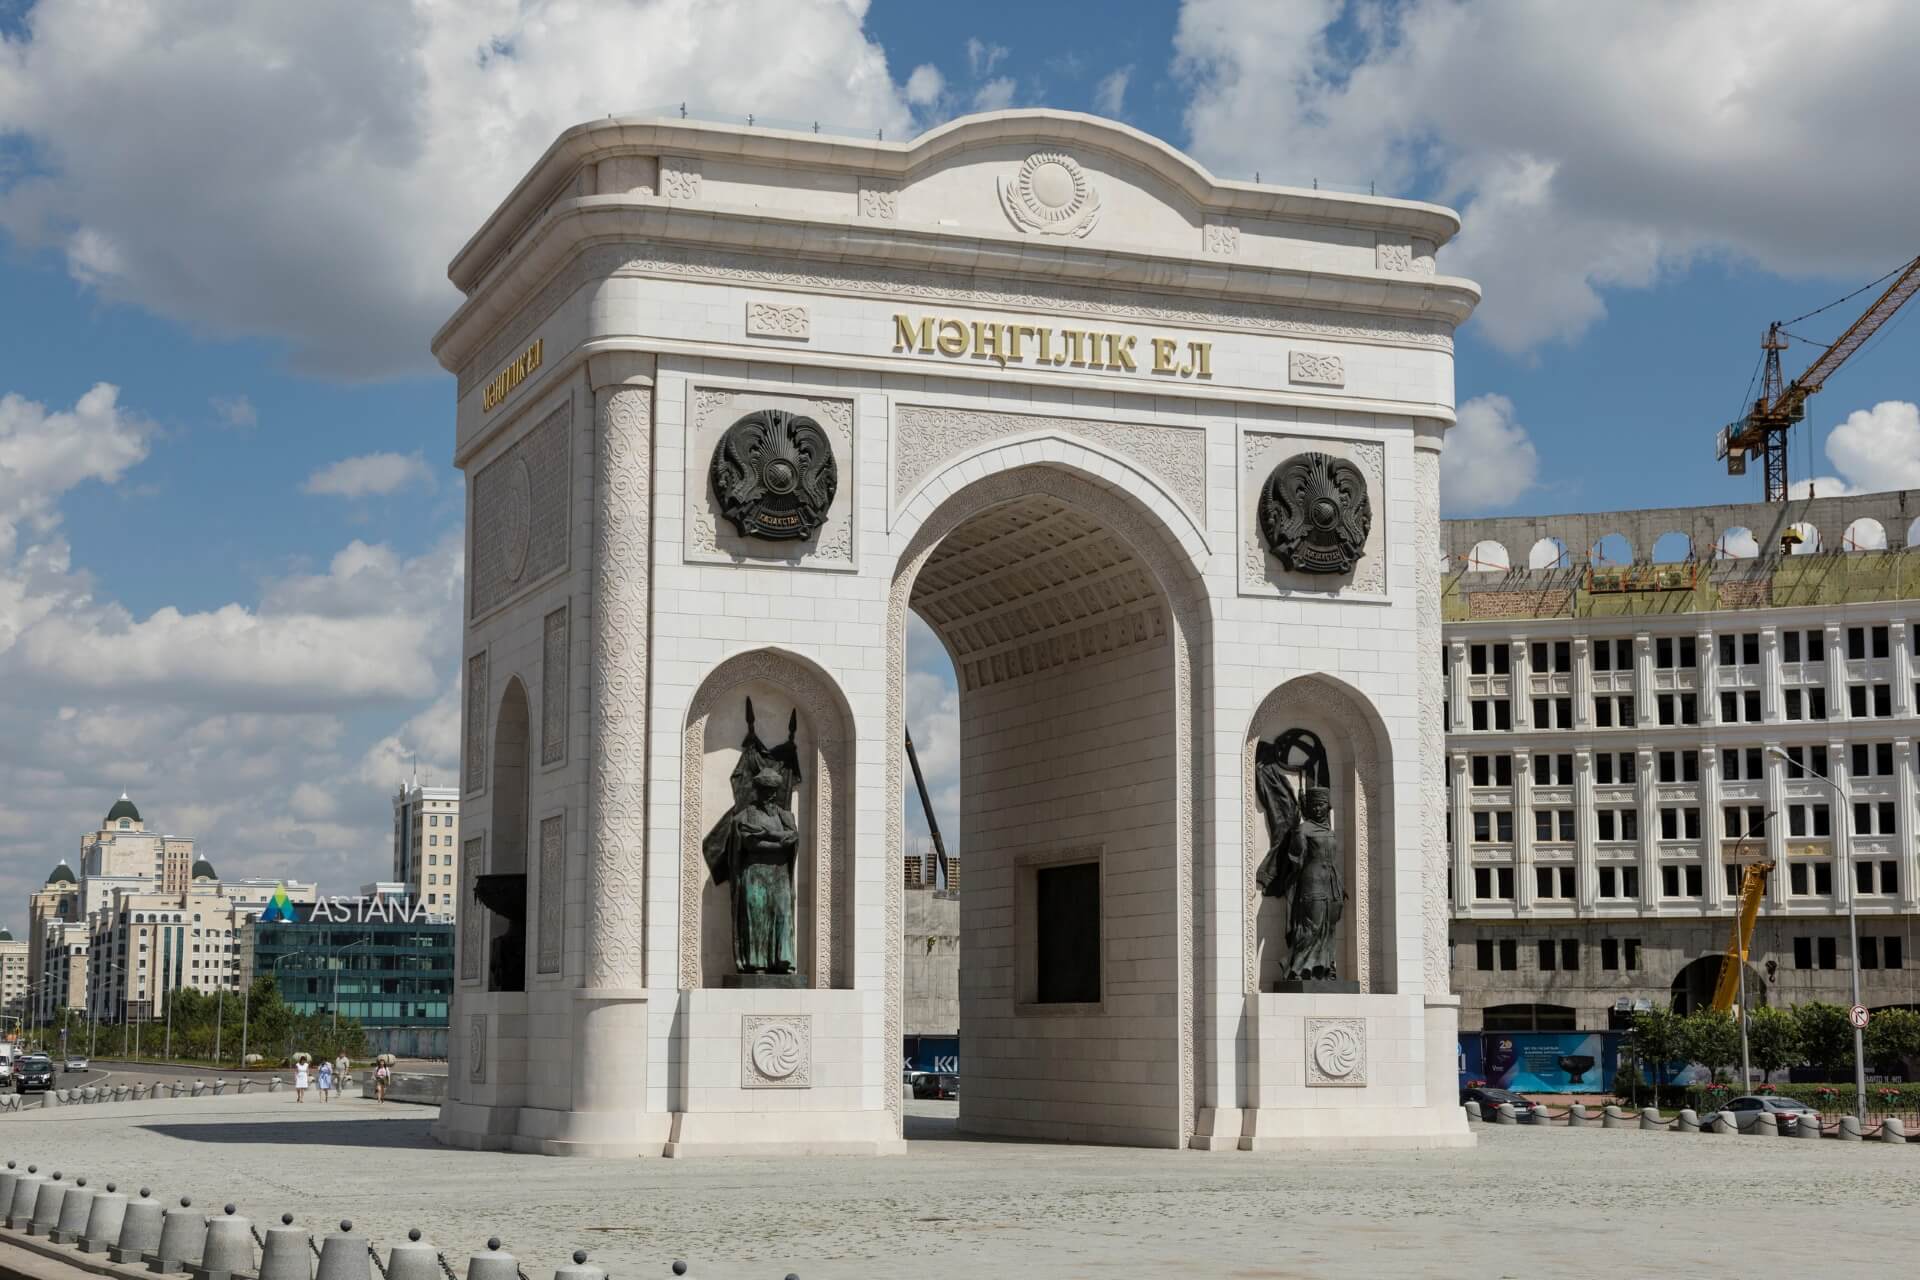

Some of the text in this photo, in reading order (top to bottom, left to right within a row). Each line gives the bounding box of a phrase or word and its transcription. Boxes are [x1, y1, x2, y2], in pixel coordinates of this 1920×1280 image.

[893, 313, 1213, 379] МӘҢГІЛІК ЕЛ
[309, 895, 433, 923] ASTANA
